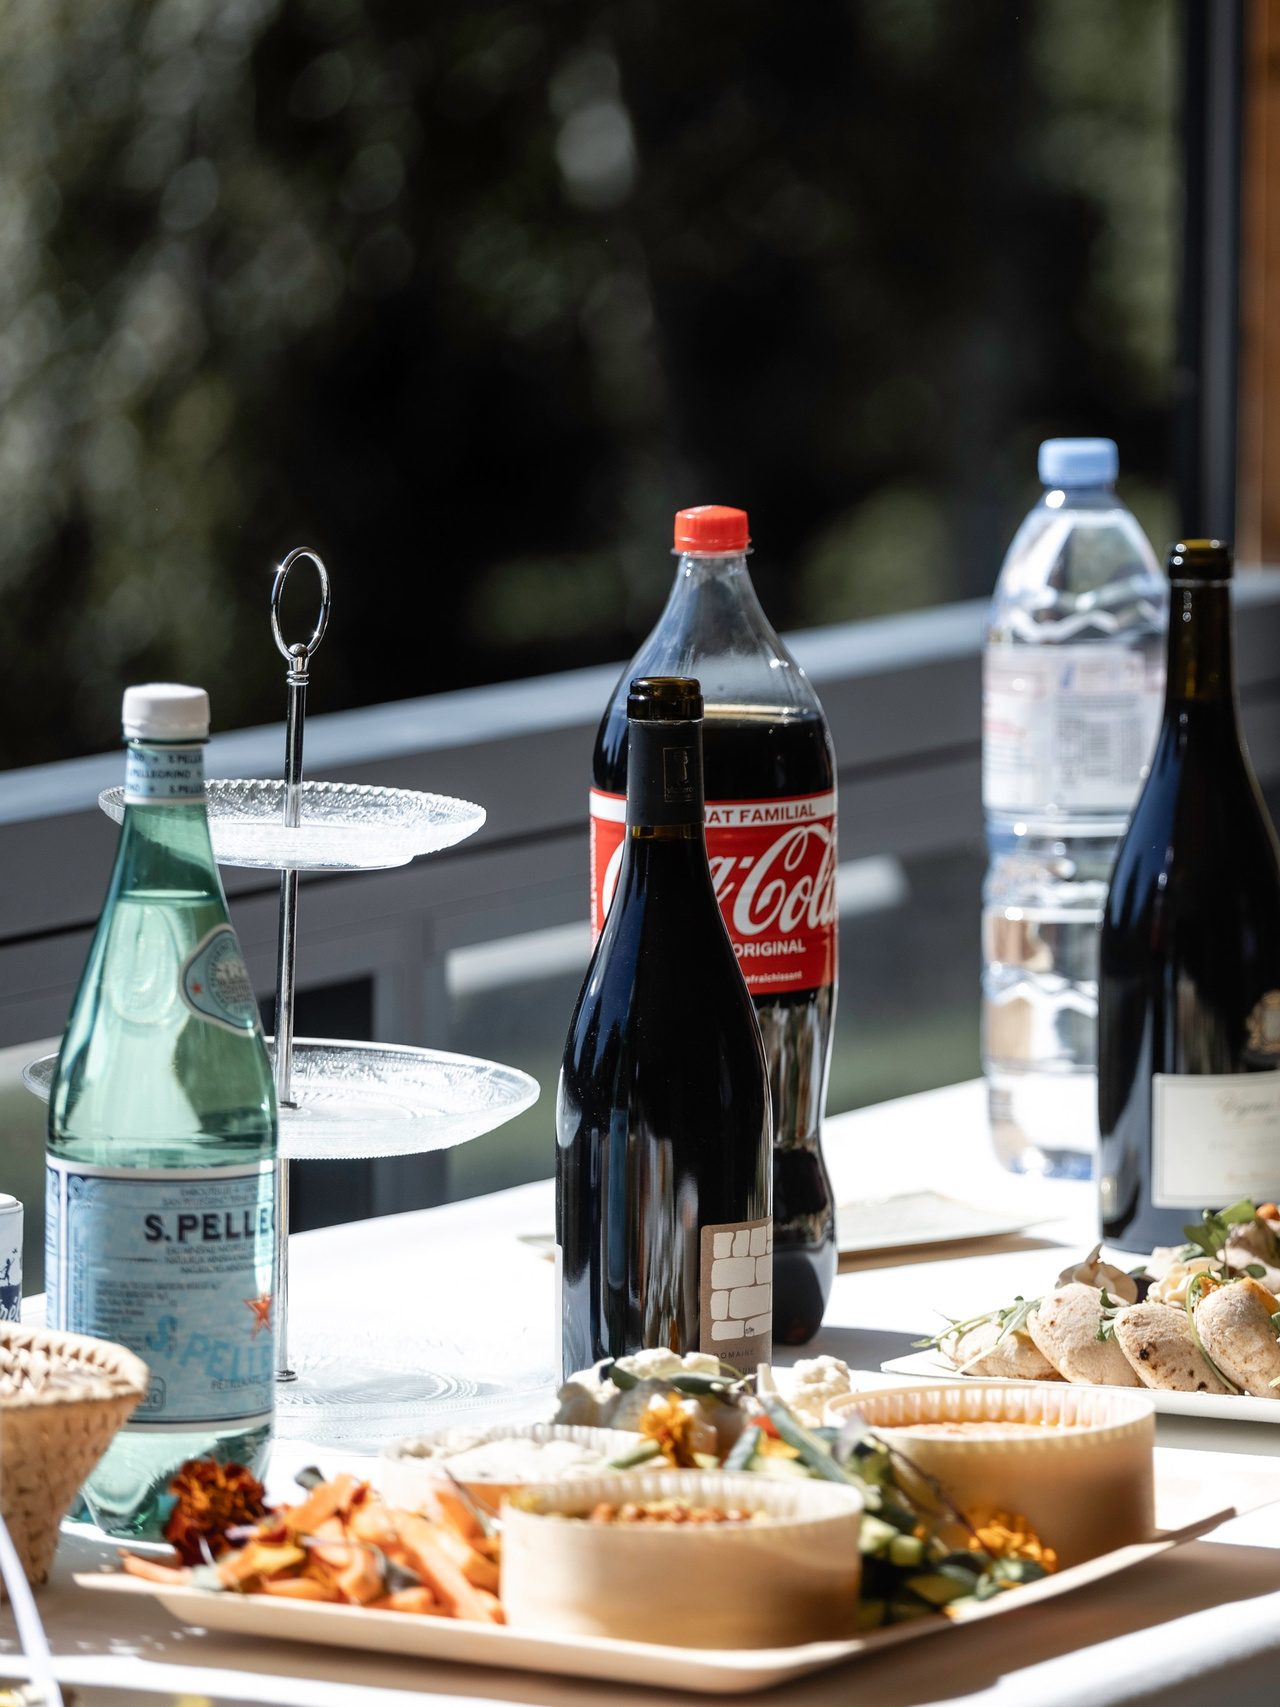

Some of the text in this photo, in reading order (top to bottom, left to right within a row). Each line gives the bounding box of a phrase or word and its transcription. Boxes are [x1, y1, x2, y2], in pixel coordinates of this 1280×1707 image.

[704, 802, 816, 824] AT FAMILIAL
[732, 938, 806, 959] ORIGINAL
[744, 970, 803, 984] afraîchissant
